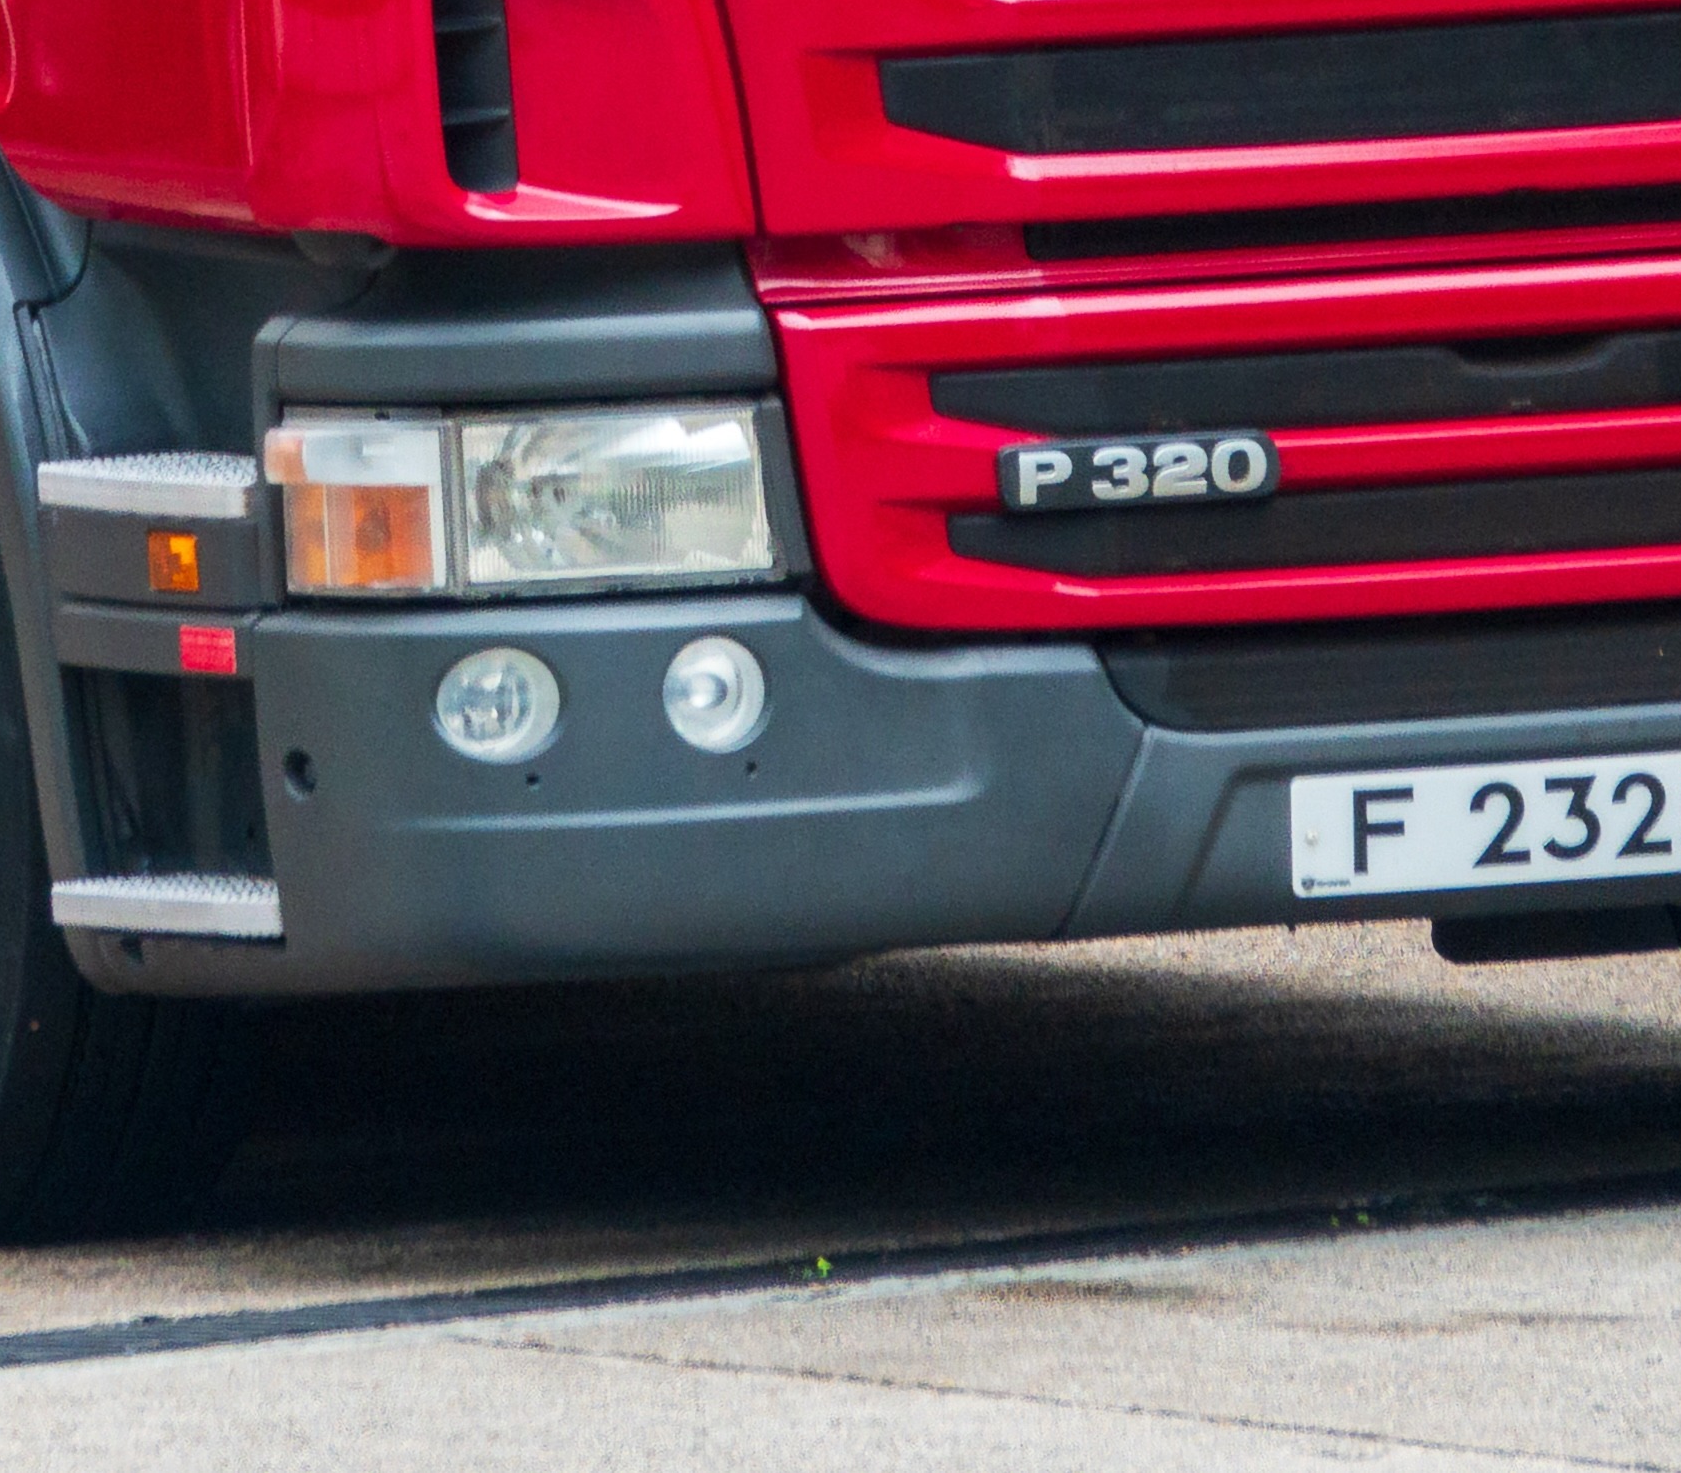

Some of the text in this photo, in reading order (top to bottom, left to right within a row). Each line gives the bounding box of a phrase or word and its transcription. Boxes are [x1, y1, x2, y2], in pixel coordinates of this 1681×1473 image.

[1018, 438, 1268, 505] P 320
[1350, 786, 1414, 874] F
